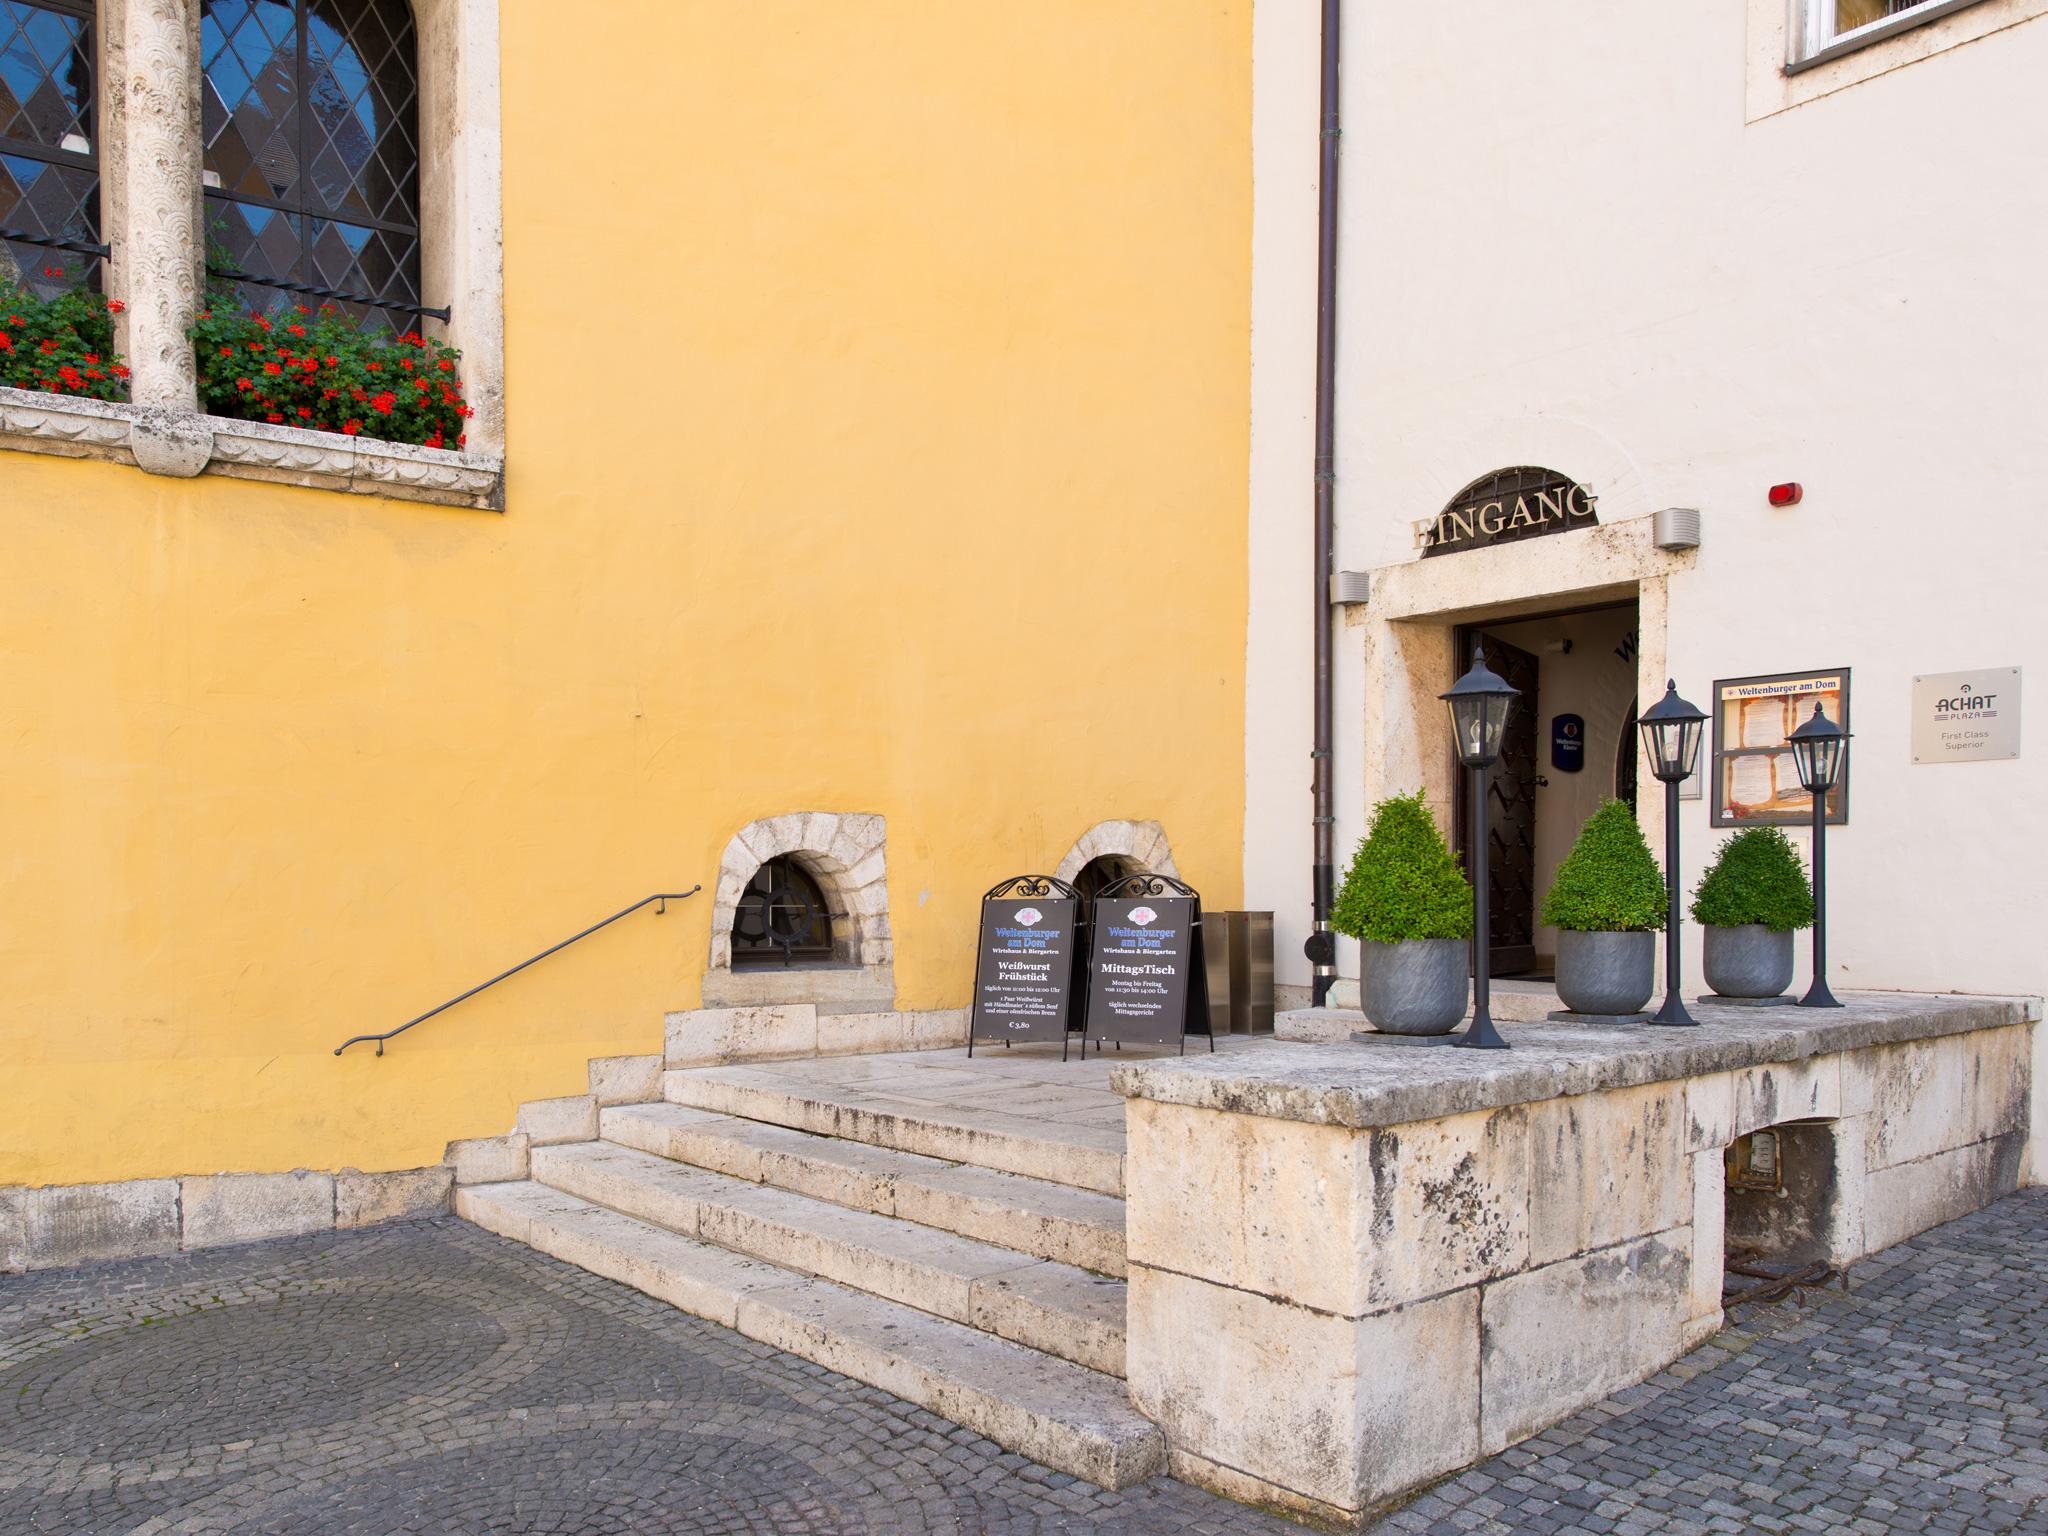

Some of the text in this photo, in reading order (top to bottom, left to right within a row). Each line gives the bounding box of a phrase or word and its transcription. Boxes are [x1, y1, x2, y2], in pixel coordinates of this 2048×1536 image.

[1411, 482, 1599, 550] EINGANG
[1738, 680, 1836, 696] Weltenburger am Dom
[1935, 695, 1998, 712] ACHAT
[1950, 711, 1981, 720] PLAZA
[1941, 731, 1989, 740] First Class
[1945, 742, 1985, 751] Superior
[995, 927, 1060, 940] Weltenburger
[1107, 927, 1176, 940] Weltenburger
[1007, 938, 1046, 948] am Dom
[1120, 938, 1161, 948] am Dom
[998, 961, 1051, 971] Weißwurst
[1101, 963, 1176, 976] MittagsTisch
[999, 972, 1048, 981] Frühstück
[1108, 1001, 1127, 1009] täglich
[1115, 1008, 1154, 1016] Mittagsgericht
